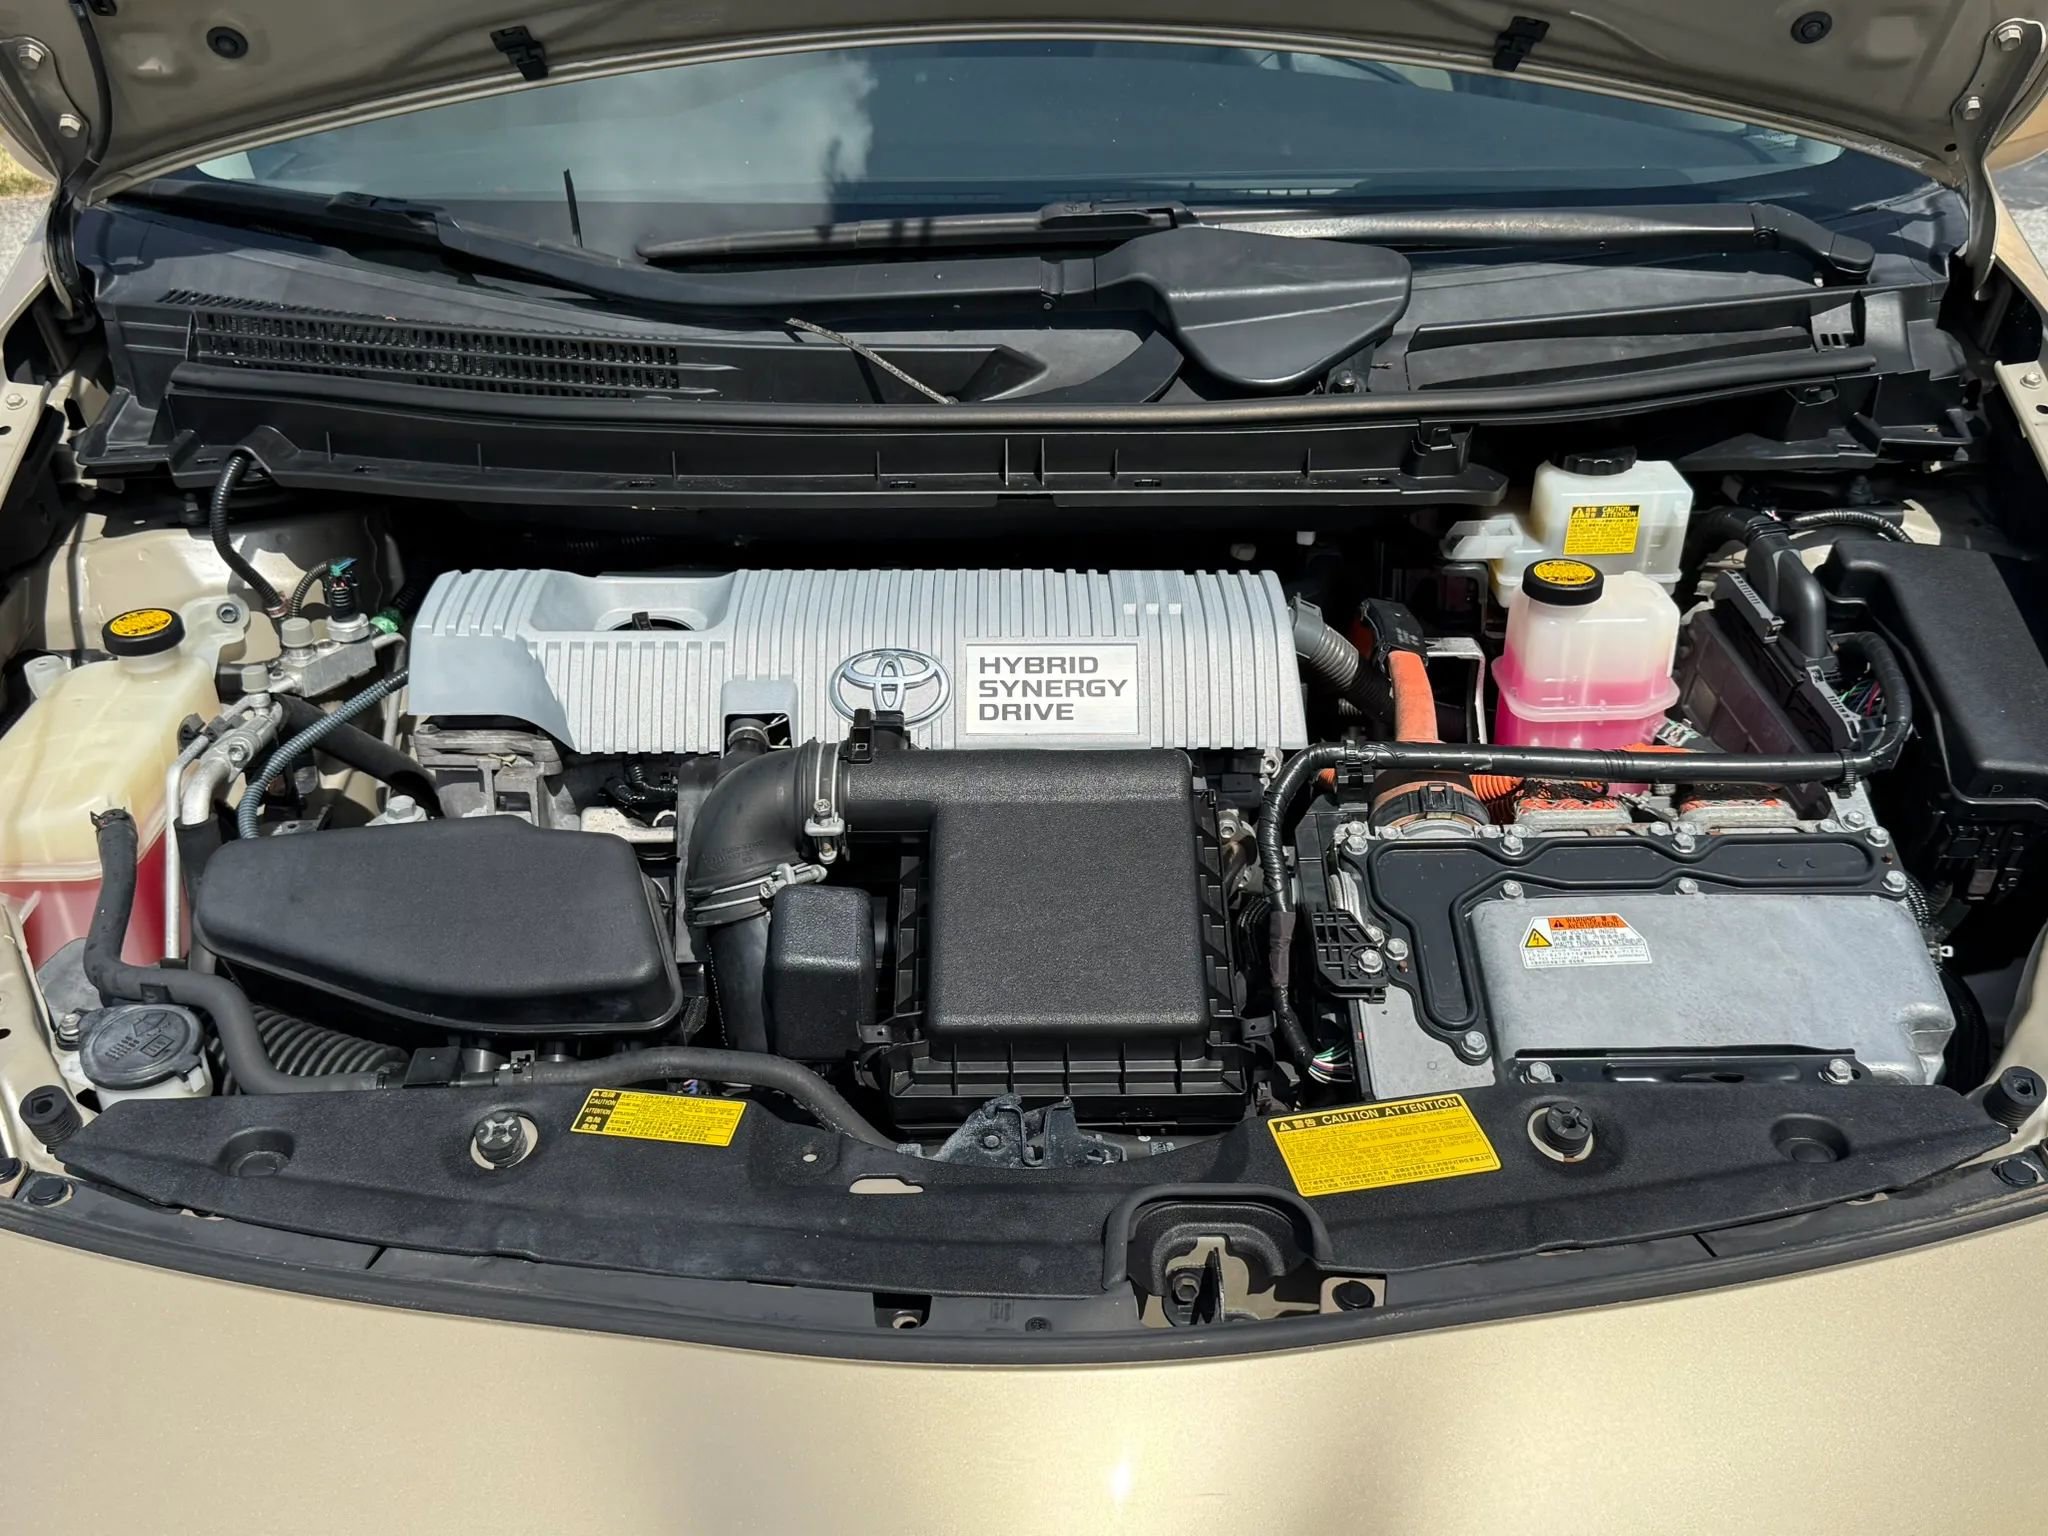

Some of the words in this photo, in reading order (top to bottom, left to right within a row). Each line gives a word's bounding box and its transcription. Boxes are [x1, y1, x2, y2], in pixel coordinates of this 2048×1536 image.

[979, 656, 1099, 674] HYBRID
[979, 679, 1128, 698] SYNERGY
[979, 703, 1074, 721] DRIVE
[584, 1107, 611, 1115] ATTENTION
[590, 1098, 617, 1106] CAUTION
[1321, 1105, 1380, 1125] CAUTION
[1385, 1097, 1459, 1117] ATTENTION
